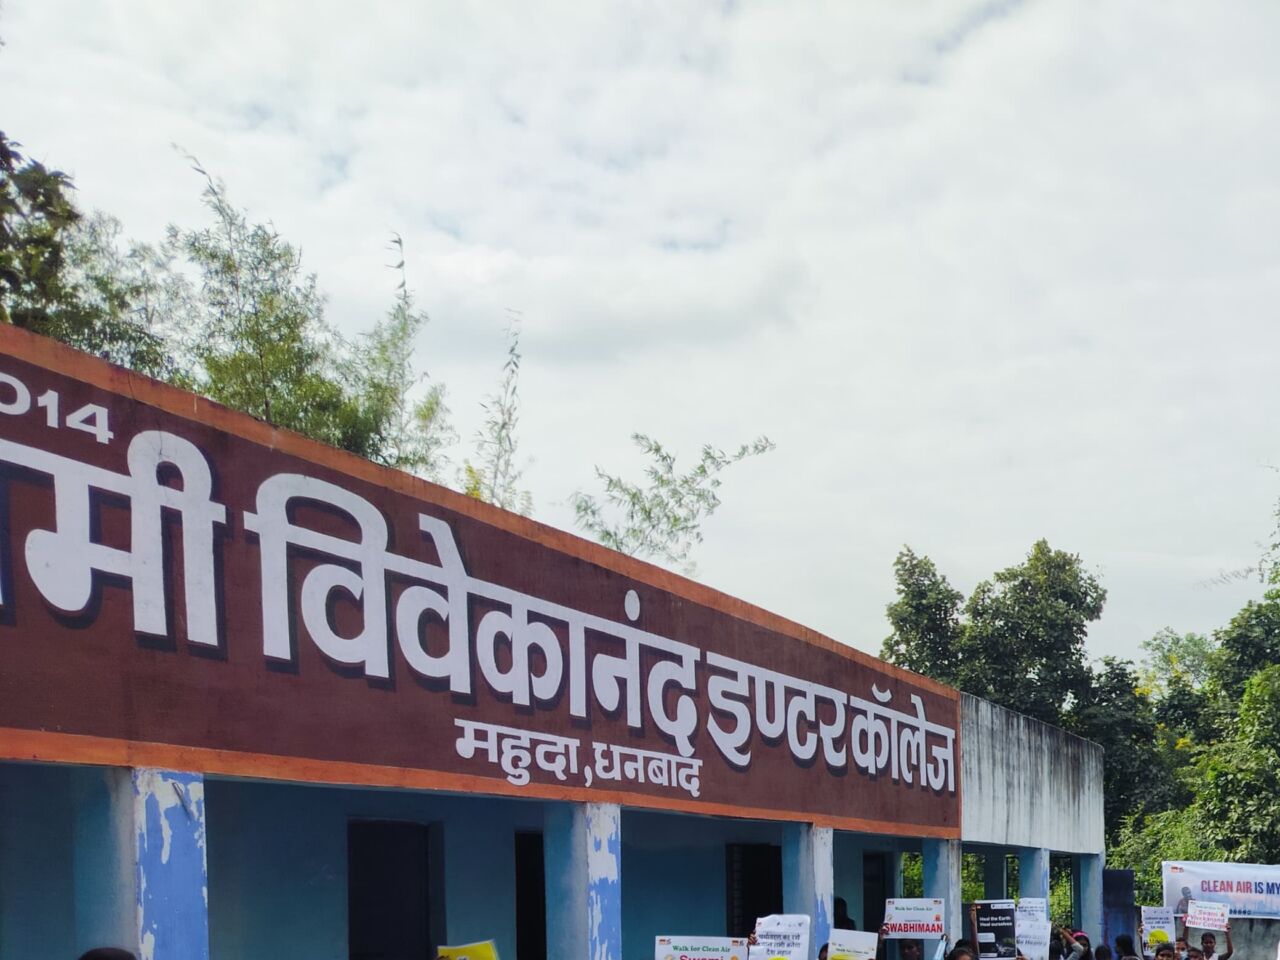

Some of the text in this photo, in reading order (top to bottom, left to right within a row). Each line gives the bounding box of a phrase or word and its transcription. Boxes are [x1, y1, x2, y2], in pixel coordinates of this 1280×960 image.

[0, 430, 226, 647] मी
[243, 473, 700, 754] विवेकानंद
[1201, 880, 1233, 892] CLEAN
[1236, 881, 1252, 893] AIR
[1254, 882, 1264, 894] IS
[1266, 882, 1280, 895] MY
